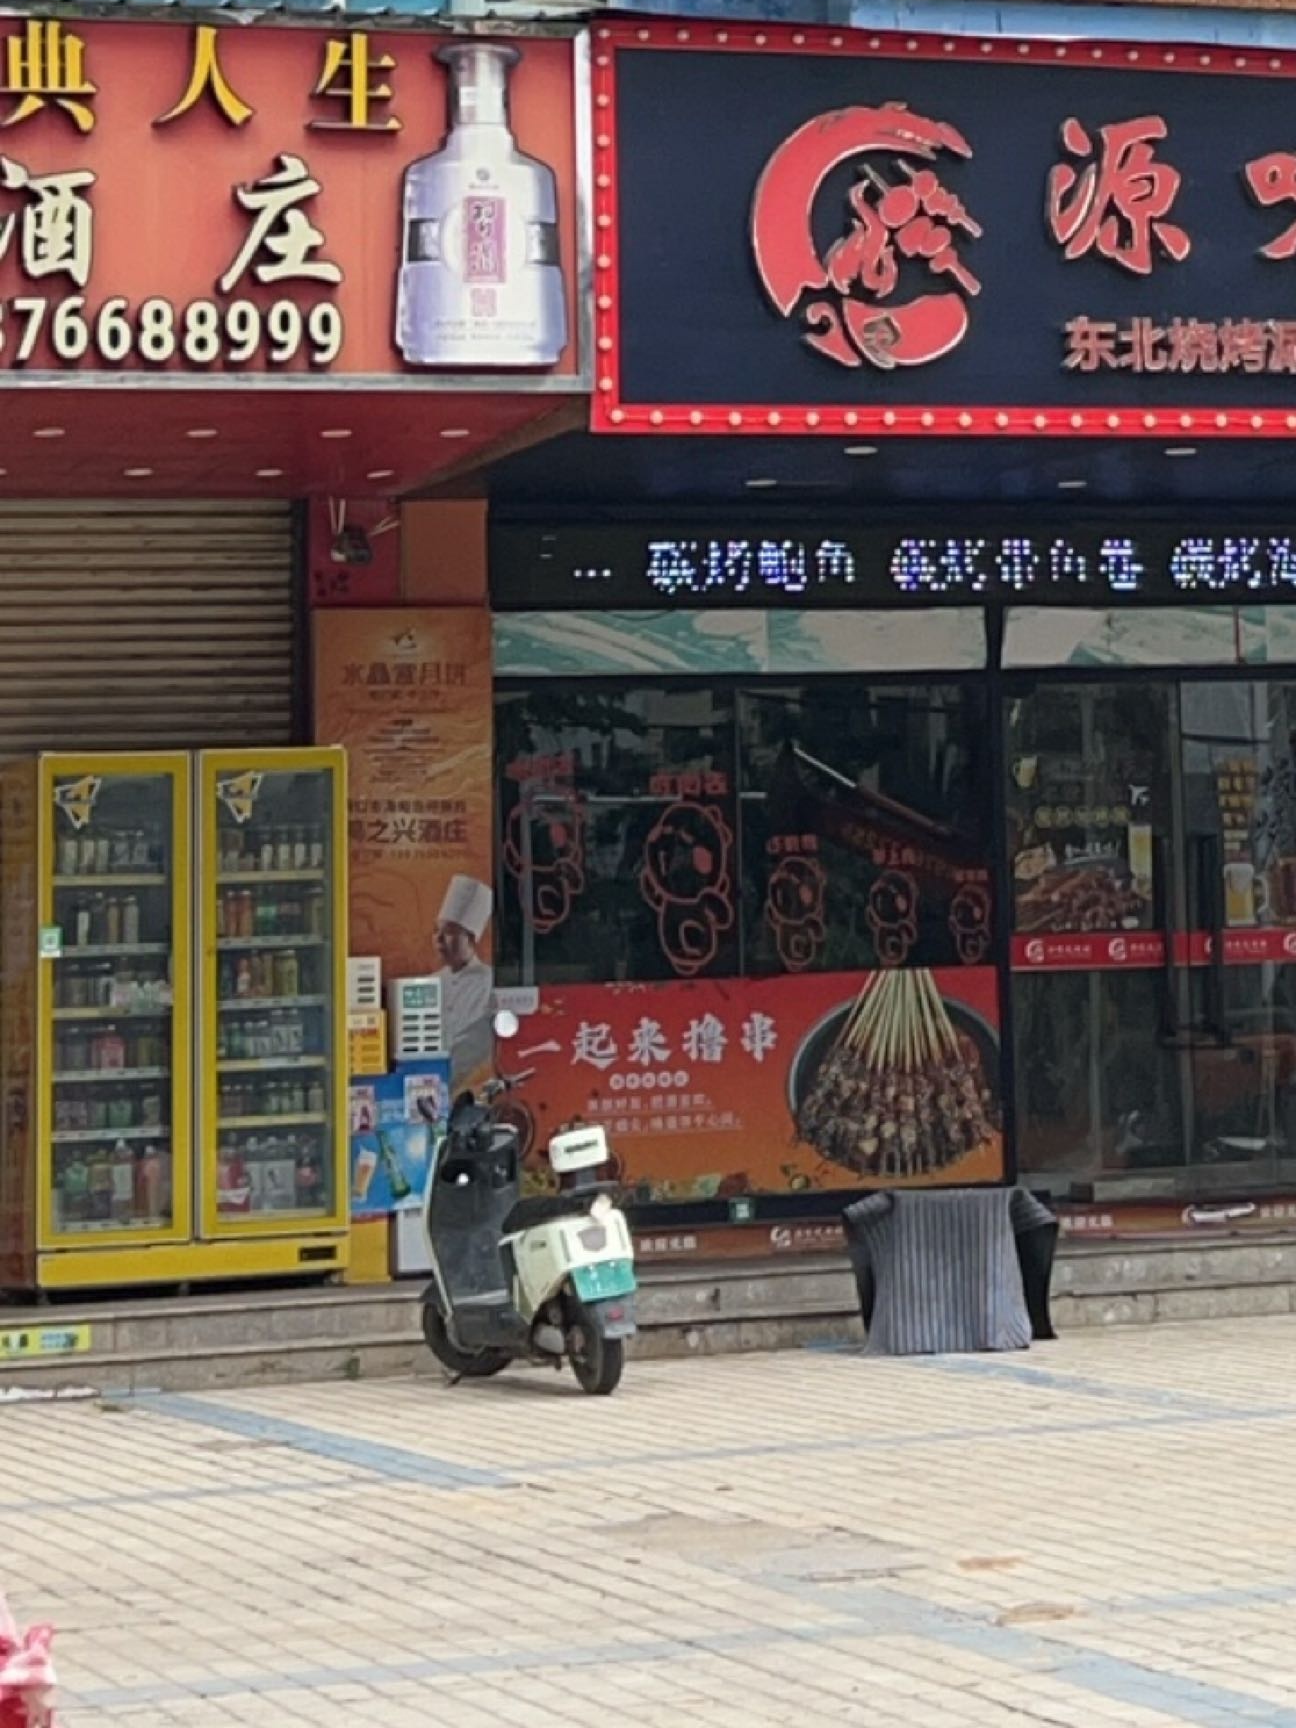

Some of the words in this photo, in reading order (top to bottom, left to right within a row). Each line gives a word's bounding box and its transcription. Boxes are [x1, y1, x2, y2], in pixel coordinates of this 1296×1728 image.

[0, 19, 403, 135] 典人生
[0, 295, 343, 365] 76688999
[516, 1012, 779, 1068] 一起来撸串
